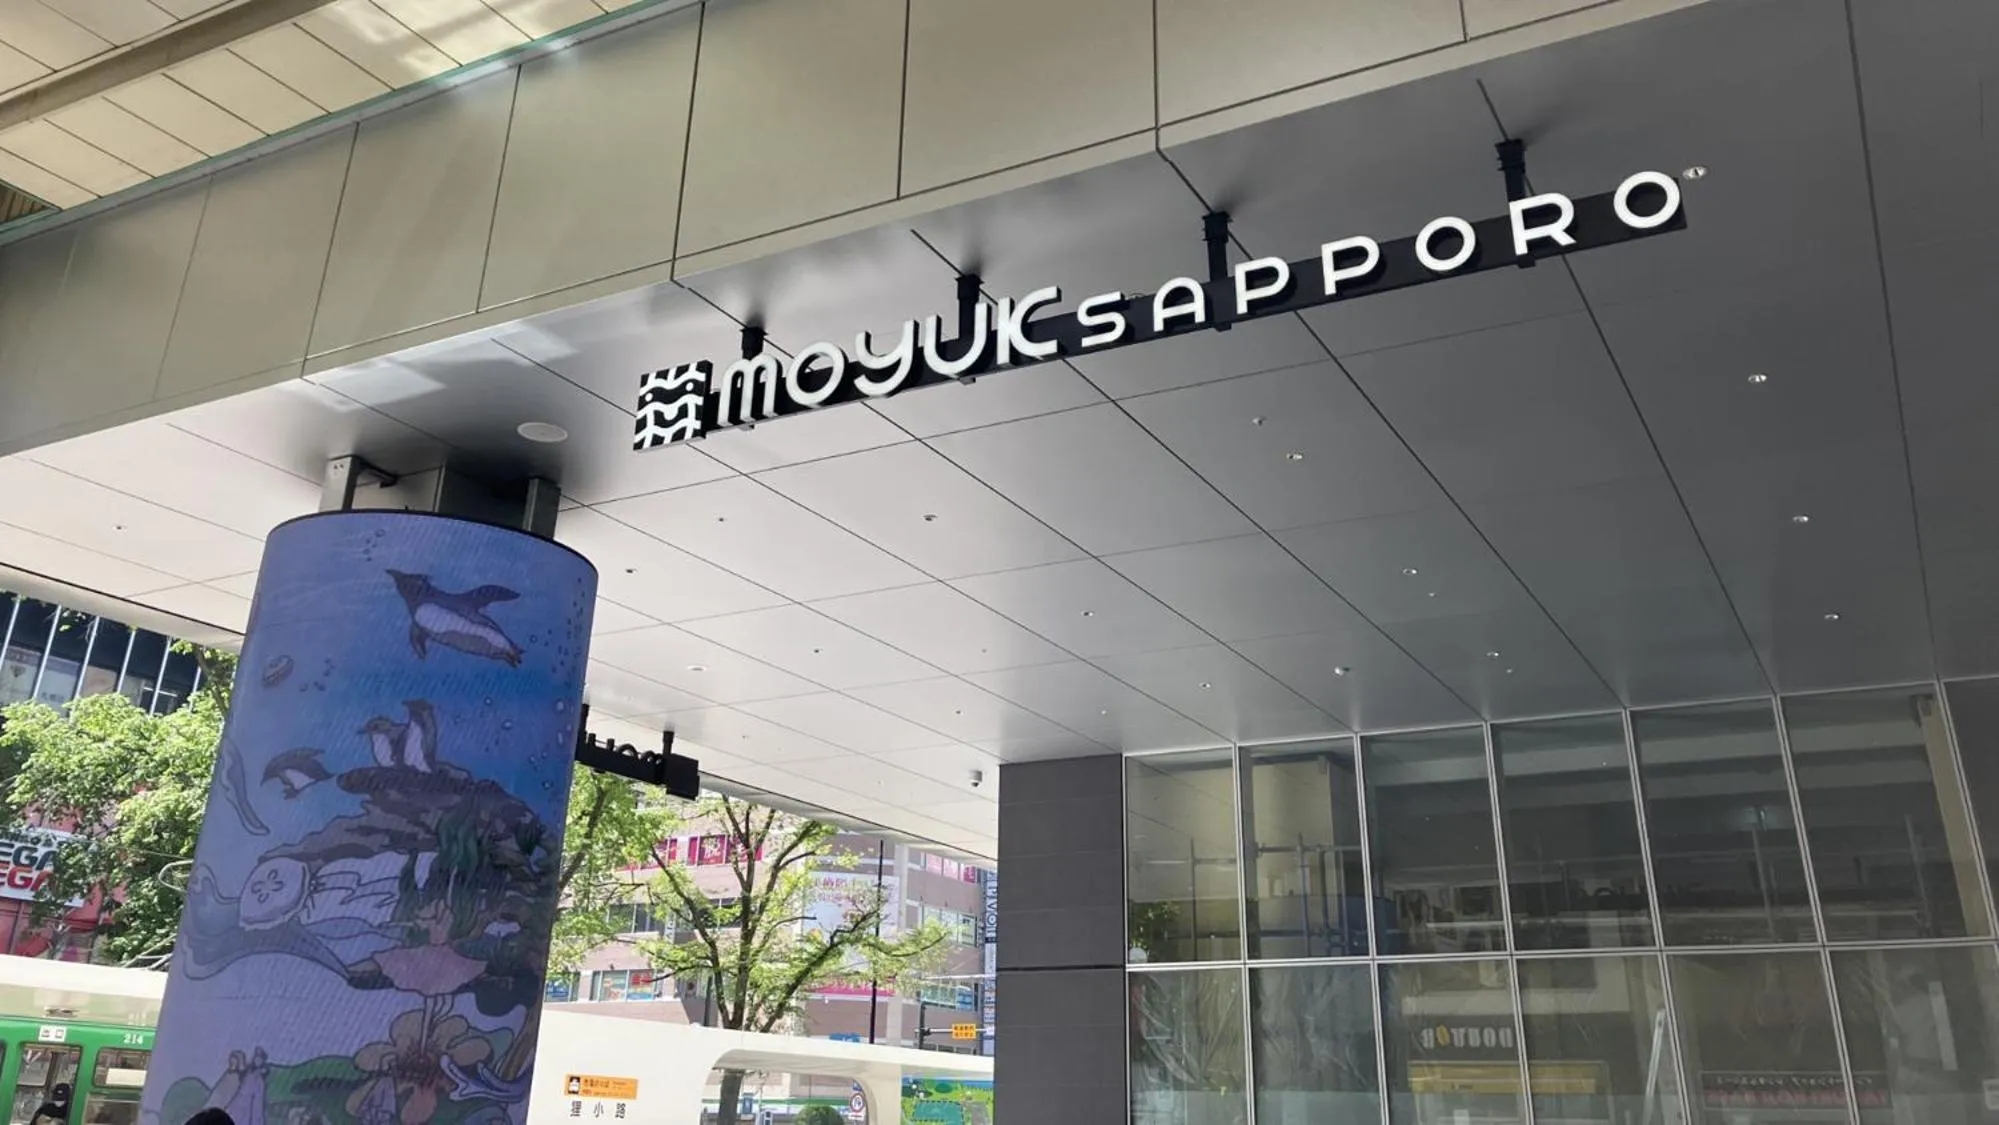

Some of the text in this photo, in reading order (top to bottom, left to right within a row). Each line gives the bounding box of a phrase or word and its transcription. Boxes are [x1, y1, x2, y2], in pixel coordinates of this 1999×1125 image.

[717, 170, 1681, 427] MOYUK SAPPORO
[123, 1032, 144, 1045] 214
